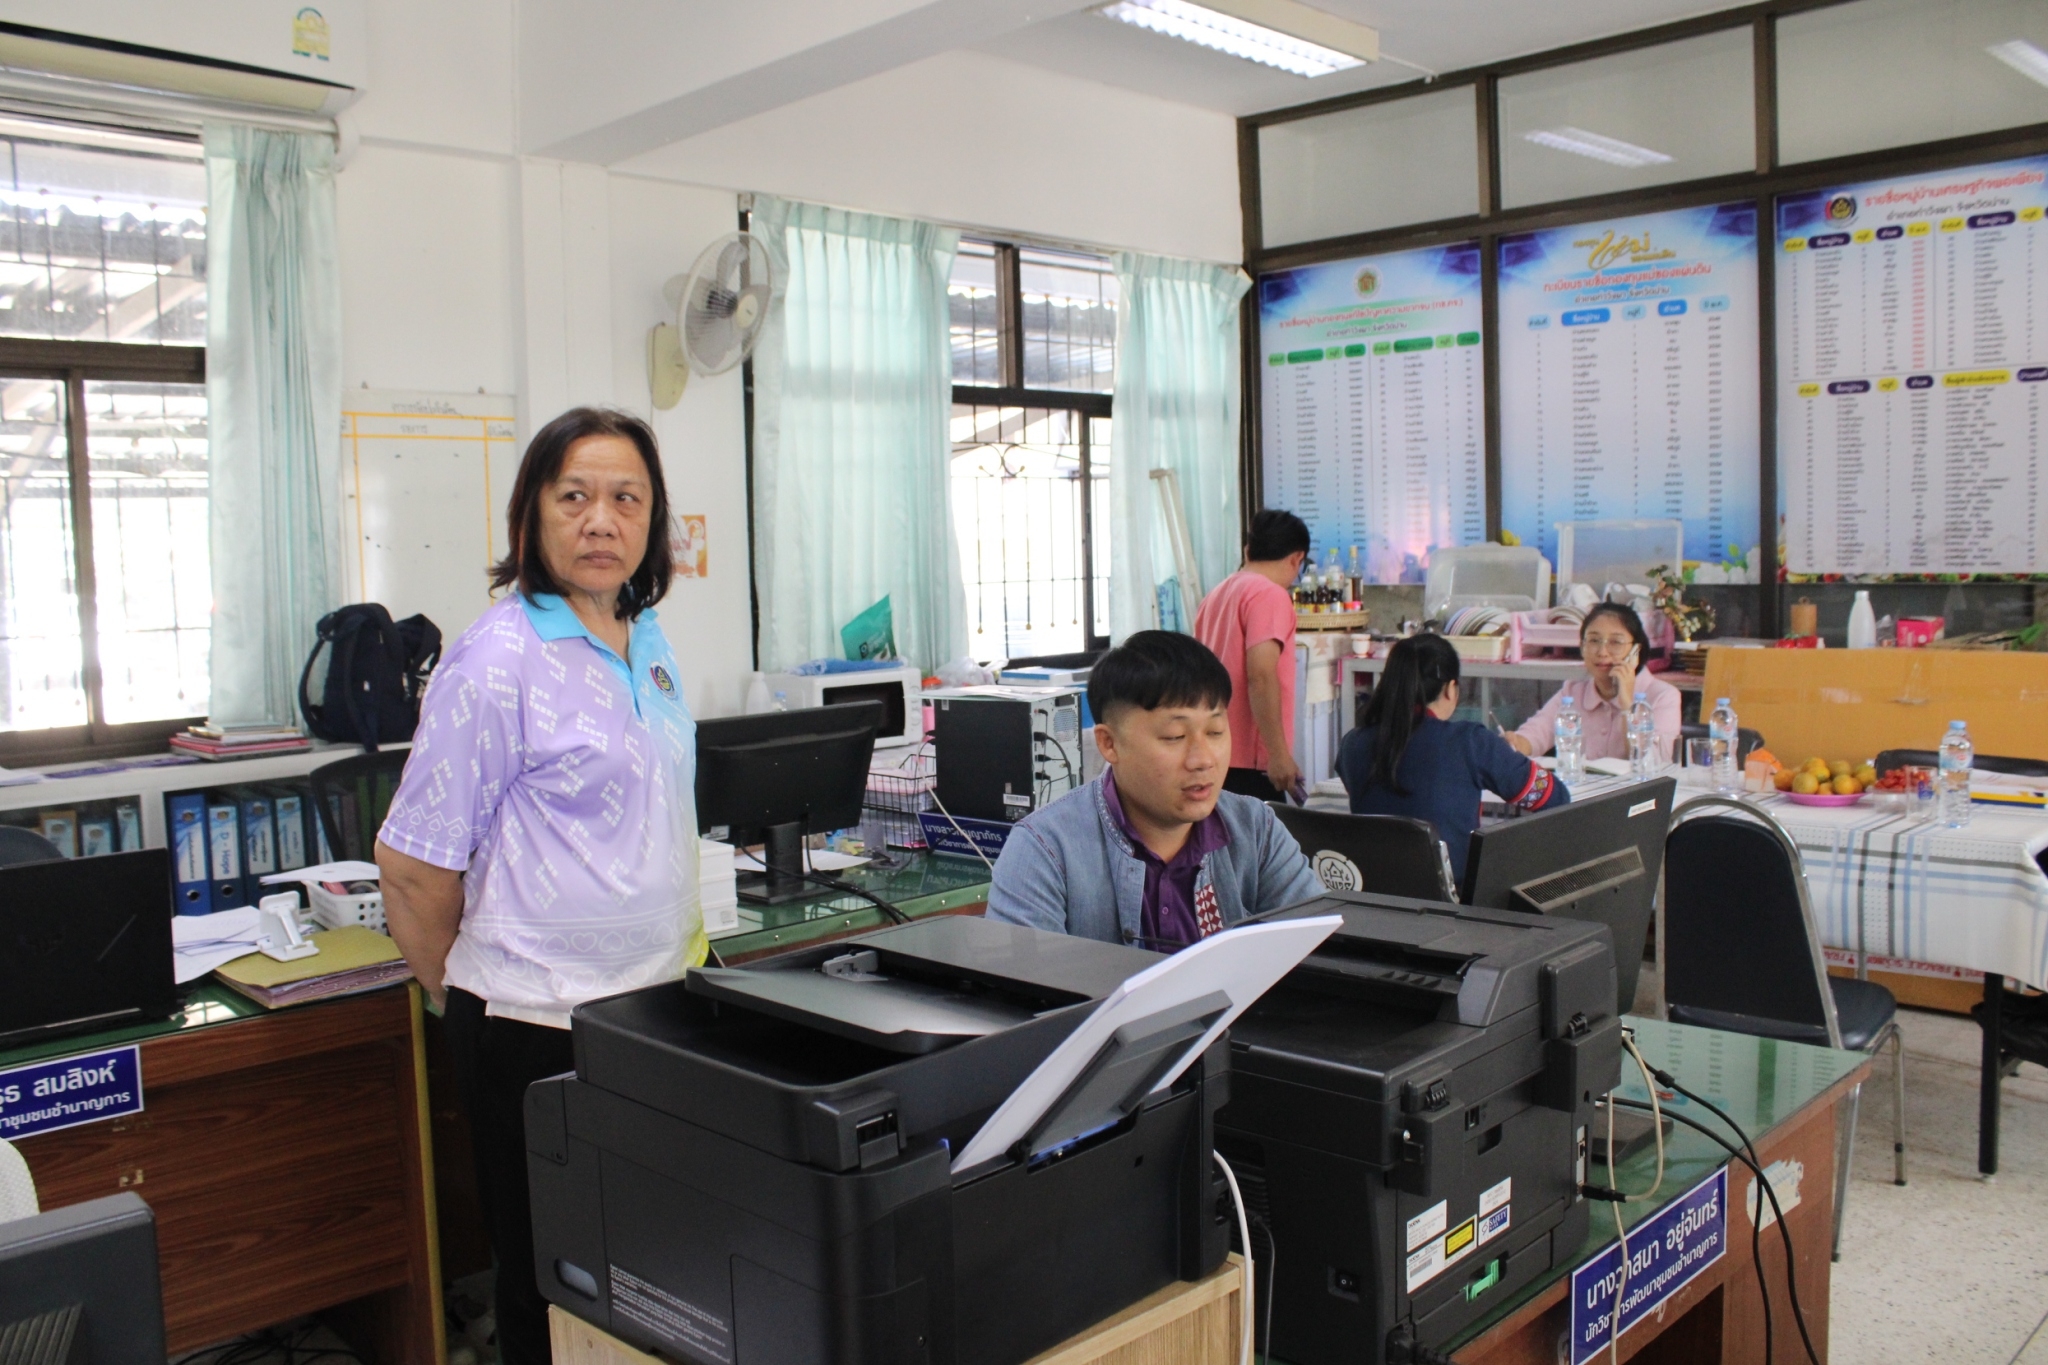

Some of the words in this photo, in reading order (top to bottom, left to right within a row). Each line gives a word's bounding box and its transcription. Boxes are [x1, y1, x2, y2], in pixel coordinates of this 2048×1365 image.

[220, 849, 231, 875] Hope
[33, 1059, 117, 1097] สมสิงห์
[0, 1091, 131, 1130] าชุมชนชำนาญการ
[1666, 1188, 1718, 1251] อยู่จันทร์
